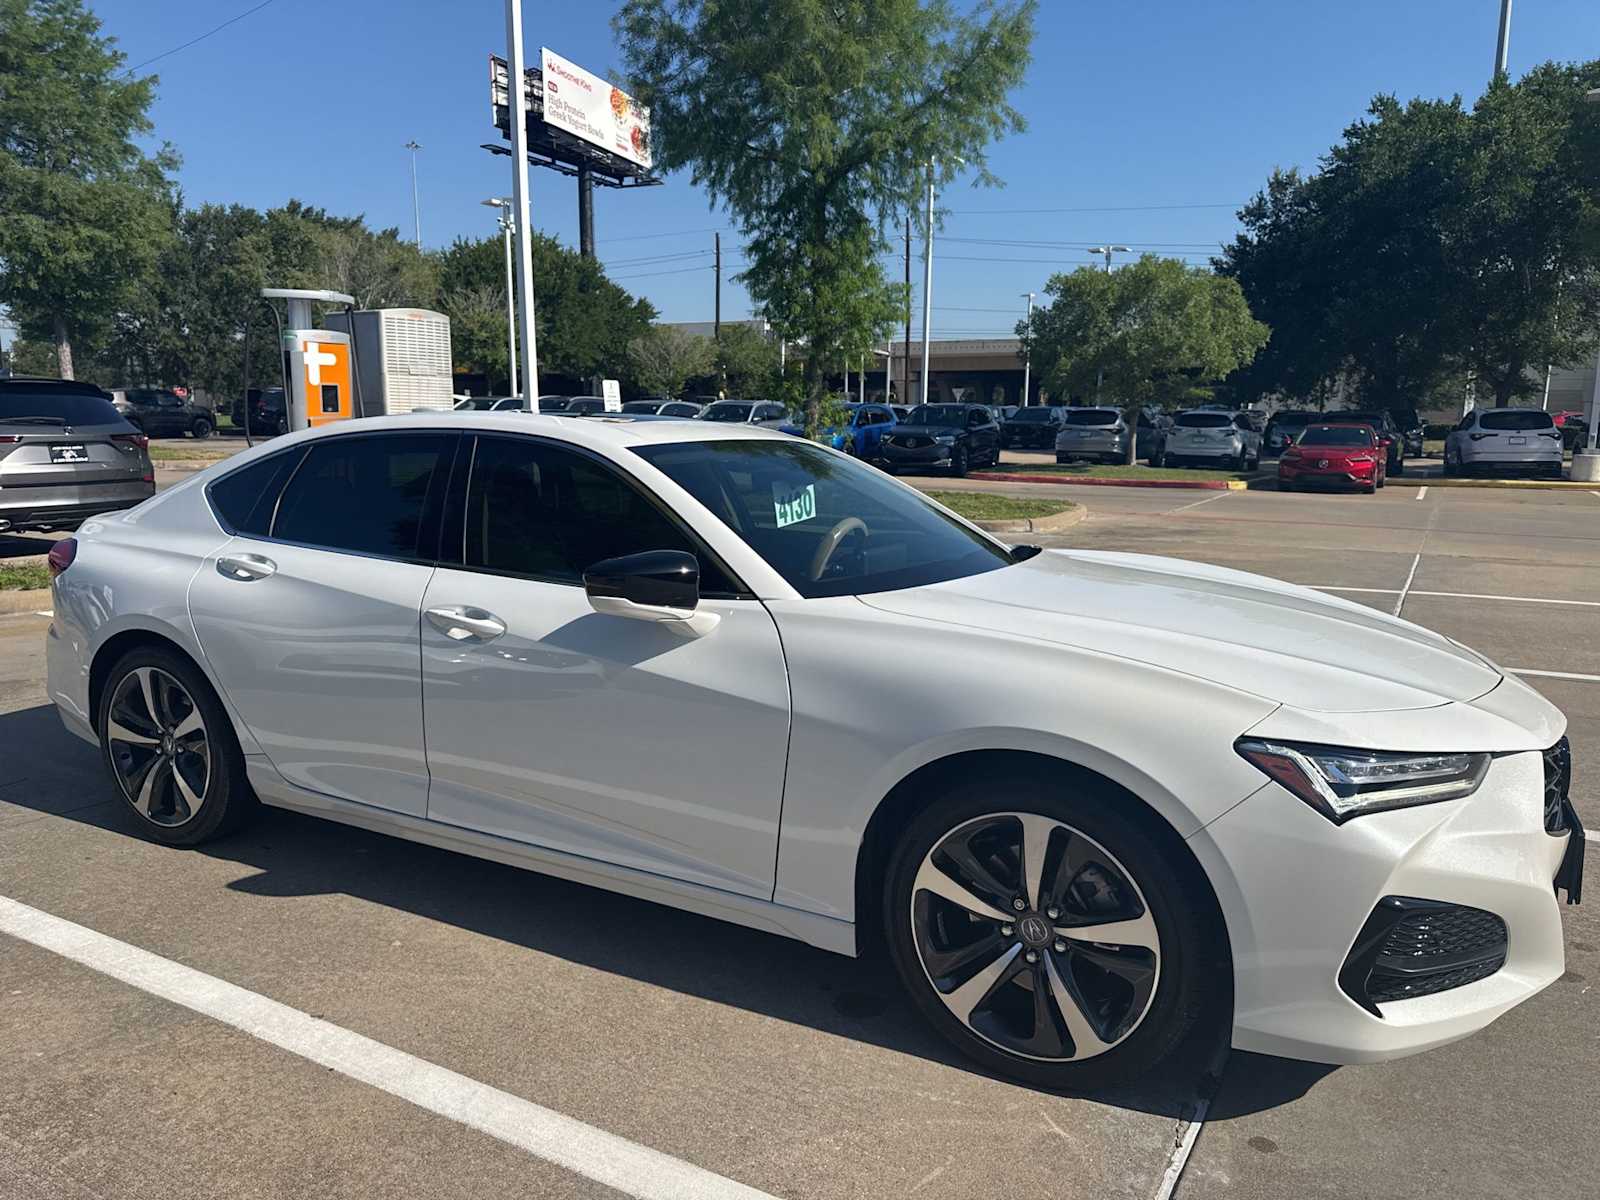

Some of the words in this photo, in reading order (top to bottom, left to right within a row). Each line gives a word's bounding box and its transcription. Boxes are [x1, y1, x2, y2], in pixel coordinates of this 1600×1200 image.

[548, 93, 563, 110] High
[563, 100, 586, 120] Protein
[548, 105, 569, 124] Greek
[568, 114, 587, 132] Yogurt
[587, 123, 605, 140] Bowls
